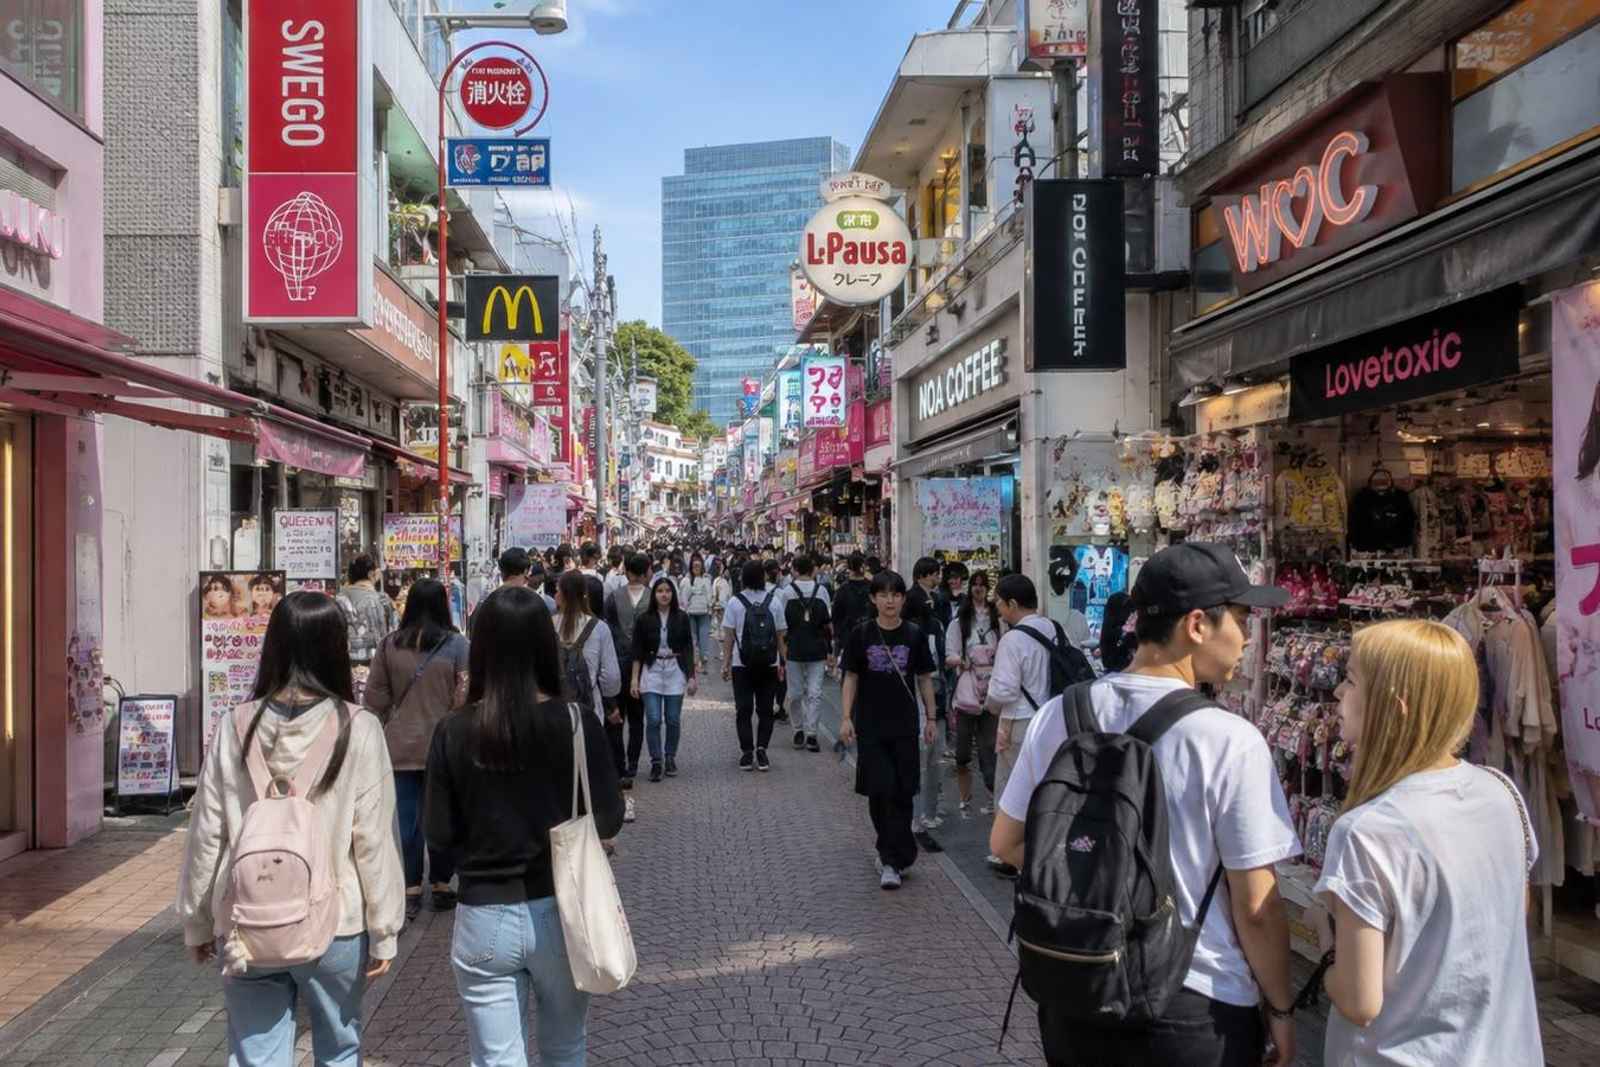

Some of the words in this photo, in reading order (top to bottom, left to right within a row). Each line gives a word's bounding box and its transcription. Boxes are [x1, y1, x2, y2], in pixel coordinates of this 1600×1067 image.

[281, 20, 325, 147] SWEGO
[467, 80, 527, 105] 消火栓
[919, 374, 945, 421] NOA
[945, 339, 1000, 407] COFFEE
[1325, 330, 1463, 399] Lovetoxic
